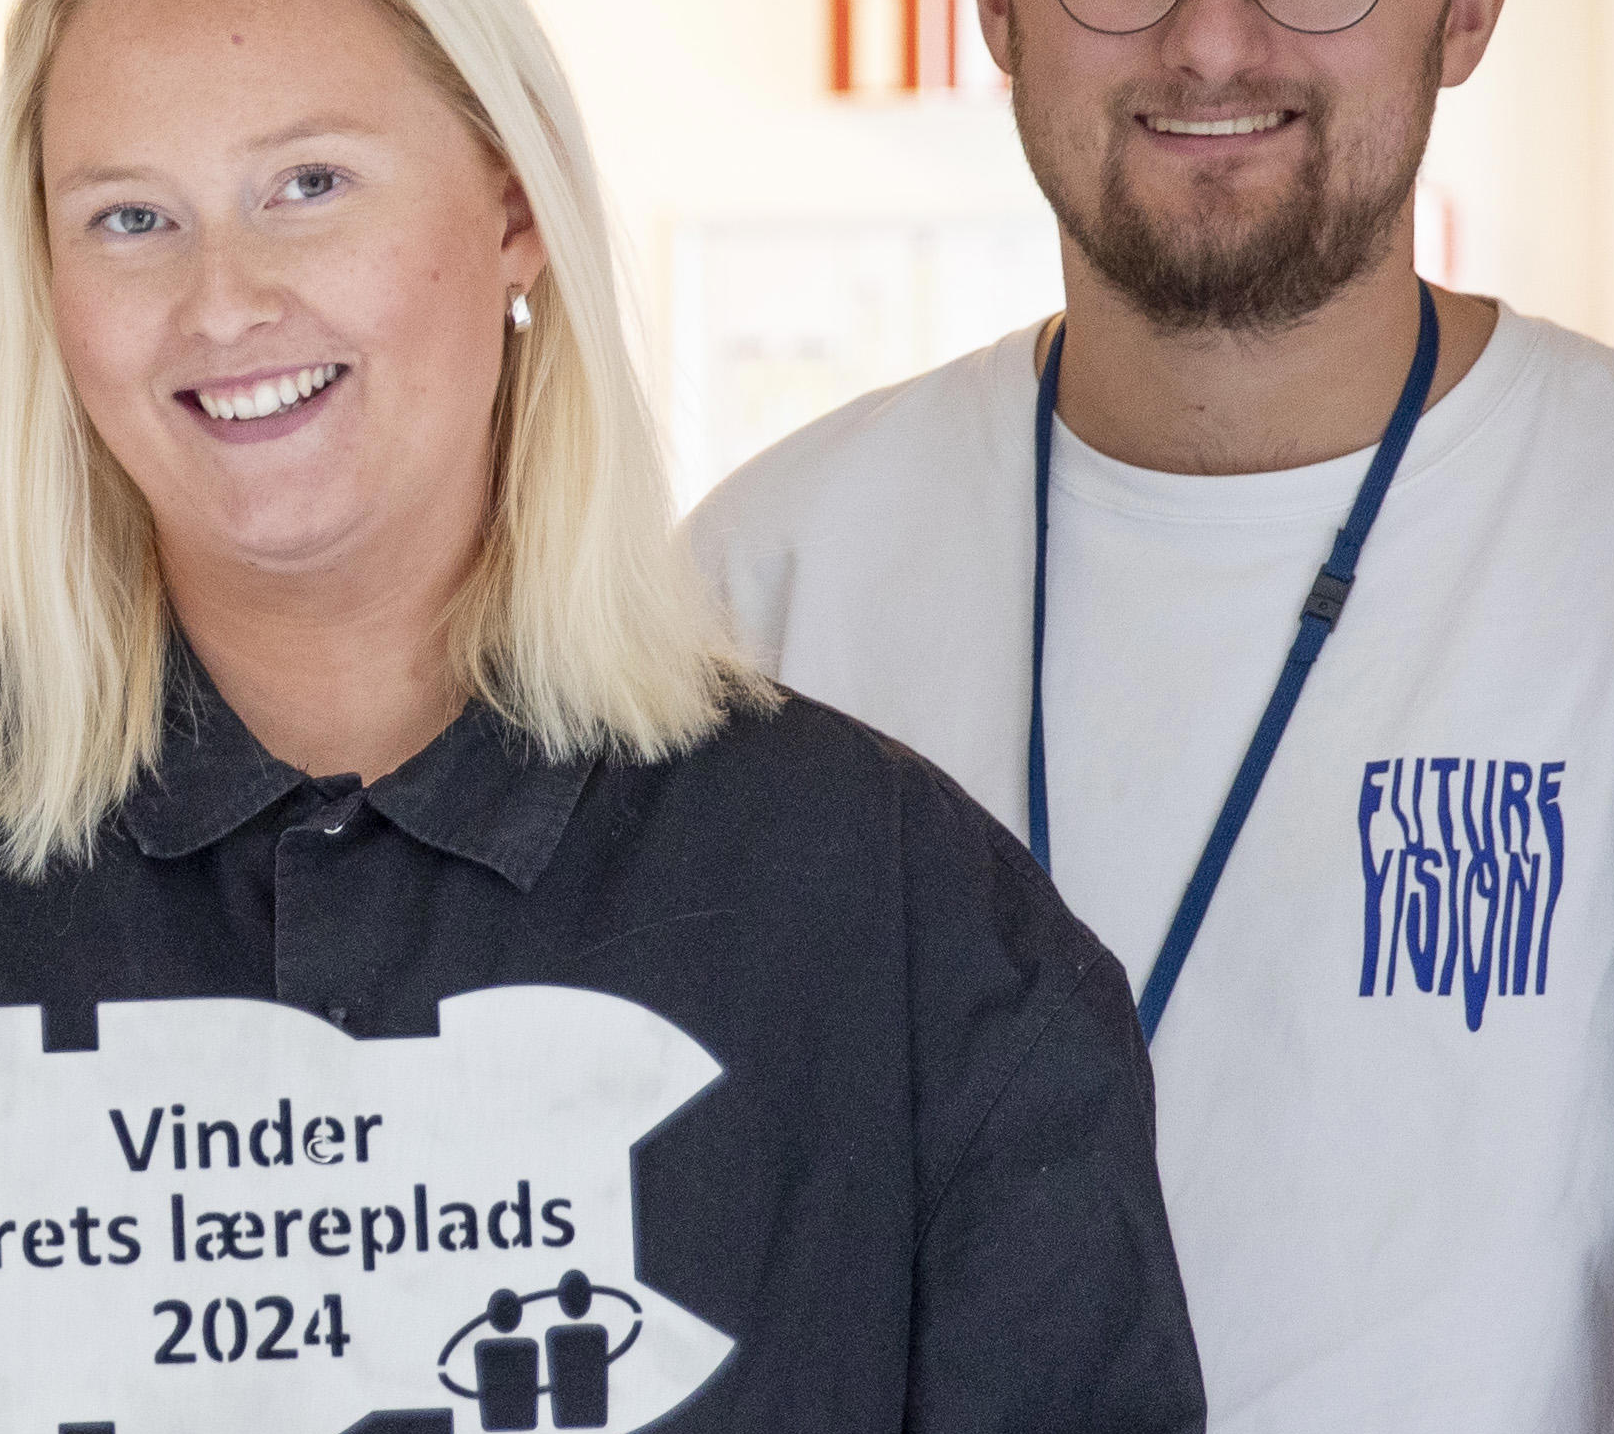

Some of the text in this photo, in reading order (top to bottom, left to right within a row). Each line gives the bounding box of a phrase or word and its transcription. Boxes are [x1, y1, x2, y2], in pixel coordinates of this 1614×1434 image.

[1359, 758, 1566, 863] FUTURE
[109, 1098, 383, 1172] Vinder
[170, 1180, 577, 1271] læreplads
[153, 1295, 351, 1365] 2024
